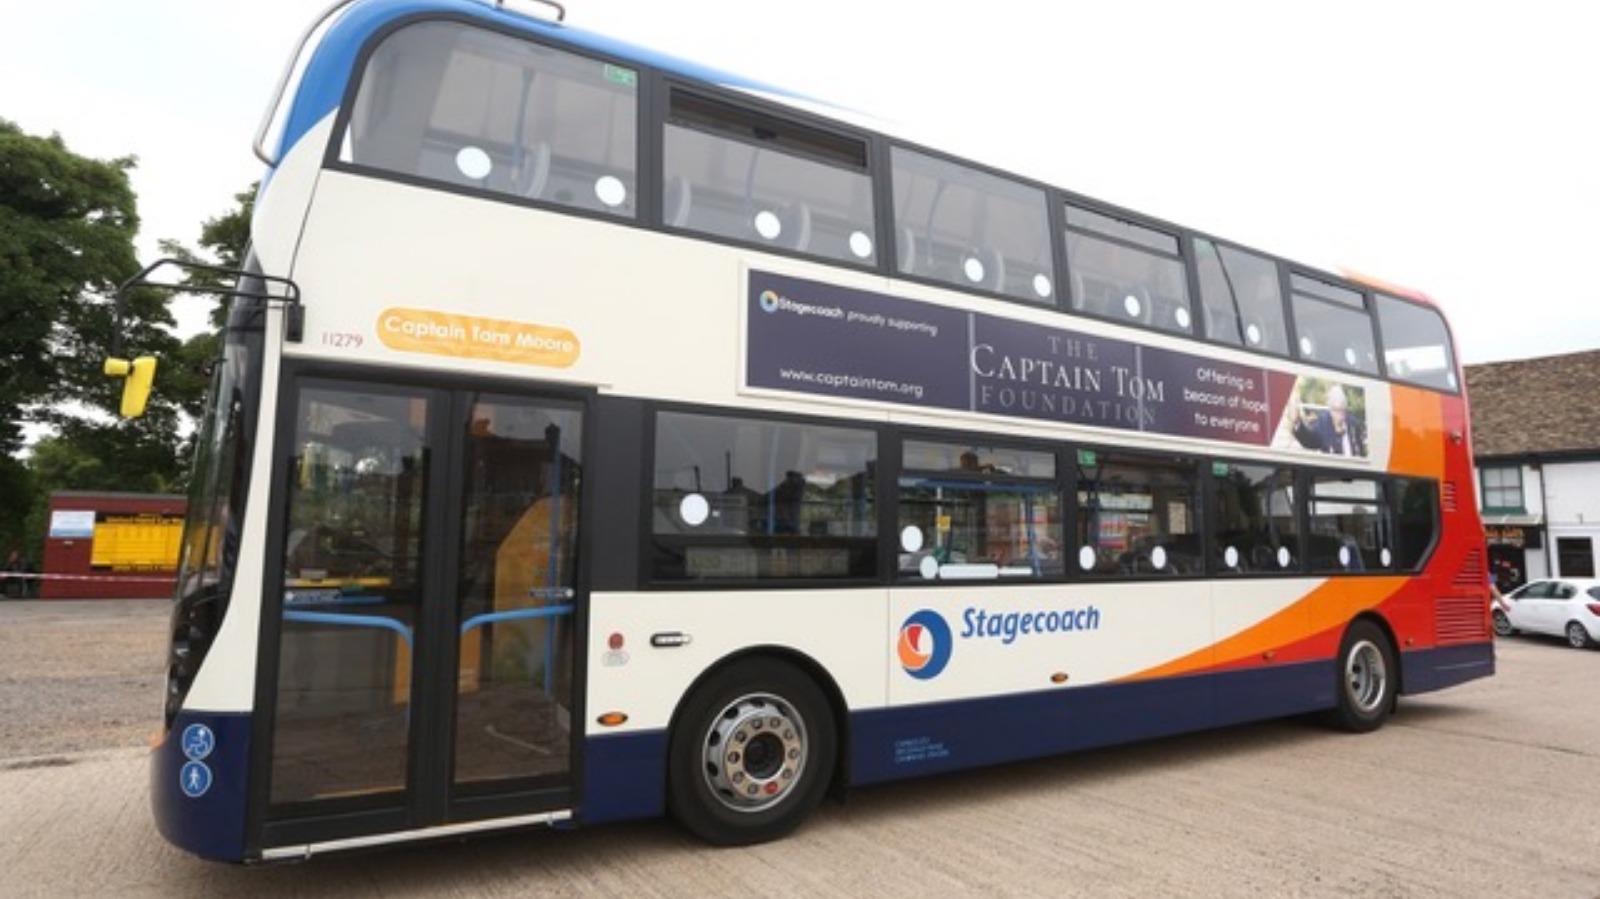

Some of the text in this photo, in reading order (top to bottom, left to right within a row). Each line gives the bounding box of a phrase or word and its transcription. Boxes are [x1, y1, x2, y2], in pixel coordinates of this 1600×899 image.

[778, 297, 938, 337] Stagecoach proudly supporting
[322, 332, 363, 348] 11279
[385, 314, 466, 341] Captain
[471, 328, 511, 346] Tom
[515, 331, 574, 353] Moore
[1047, 335, 1099, 361] THE
[780, 368, 924, 398] www.captaintom.org
[970, 343, 1165, 402] CAPTAIN TOM
[1196, 367, 1243, 391] Offering
[981, 385, 1157, 425] FOUNDATION
[1183, 386, 1269, 414] beacon of hope
[1194, 411, 1261, 434] to everyone
[960, 604, 1100, 645] Stagecoach
